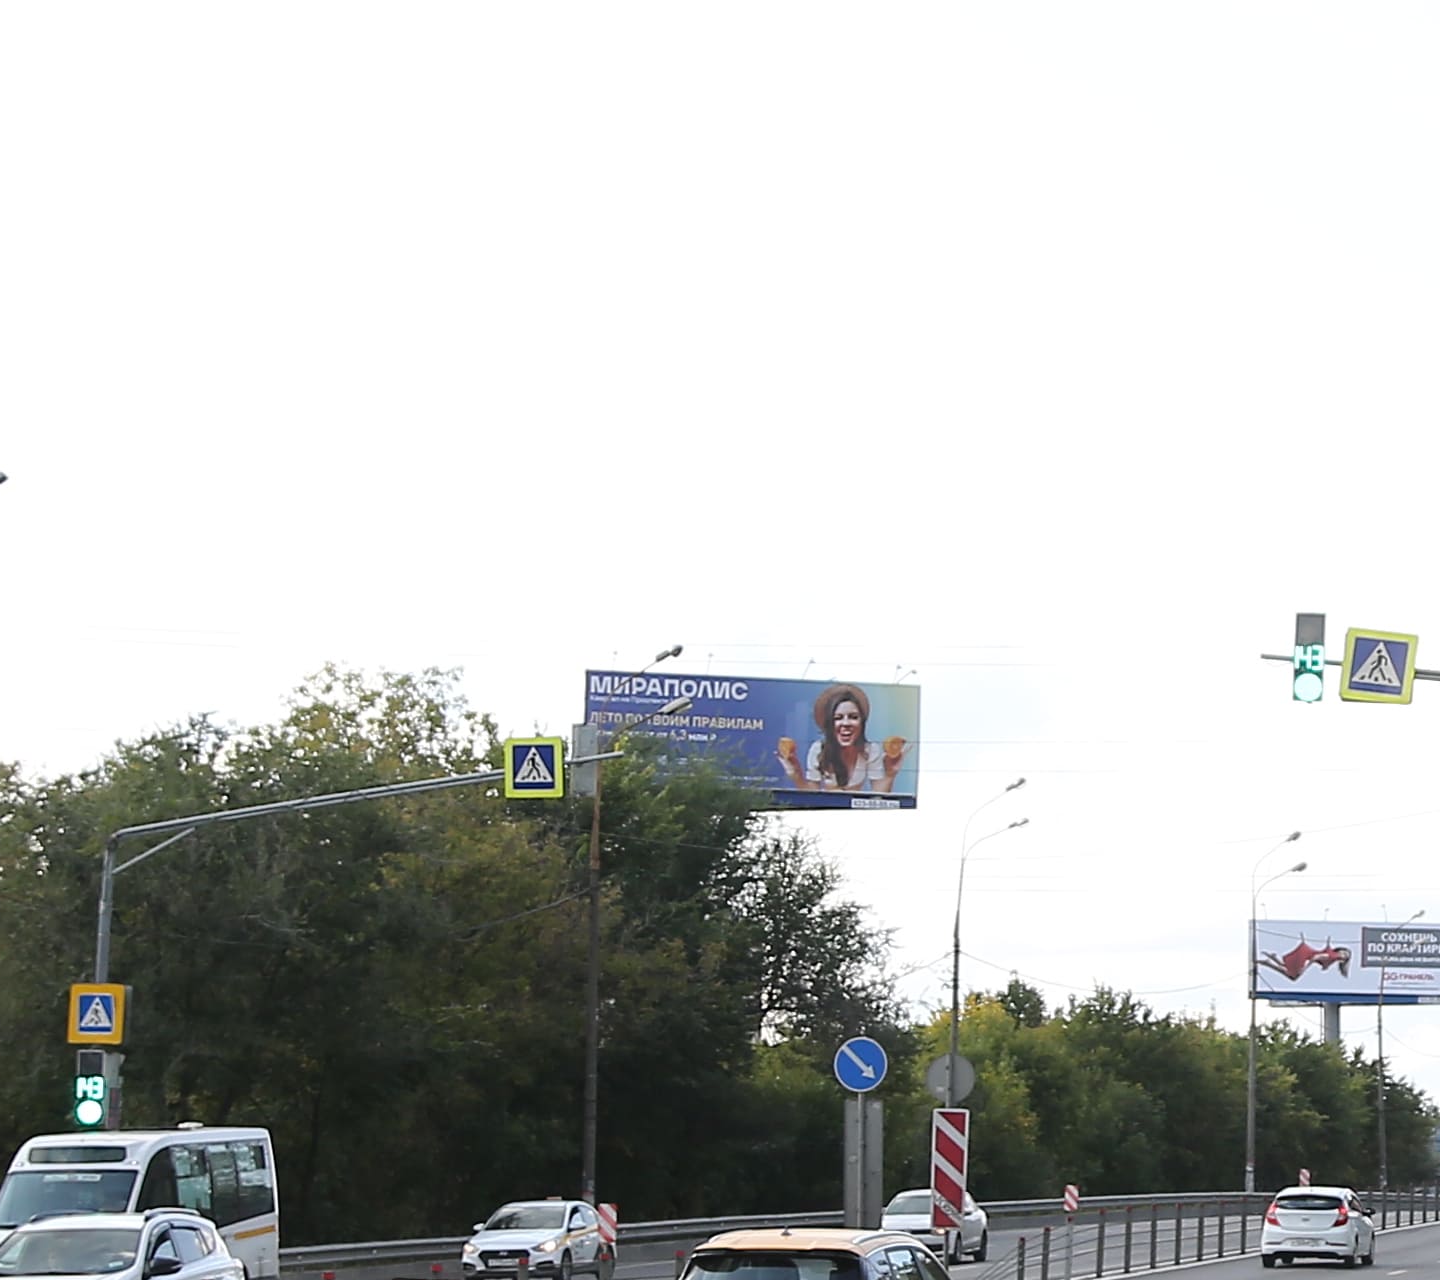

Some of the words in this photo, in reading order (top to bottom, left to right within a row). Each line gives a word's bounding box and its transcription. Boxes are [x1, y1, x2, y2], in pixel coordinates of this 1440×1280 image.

[590, 675, 749, 701] МИРАПОЛИС
[590, 711, 623, 724] ЛЕТО
[692, 717, 764, 731] ПРАВИЛАМ
[1381, 932, 1438, 943] СОХНЕШЬ
[1367, 943, 1385, 953] ПО
[76, 1076, 105, 1099] 143
